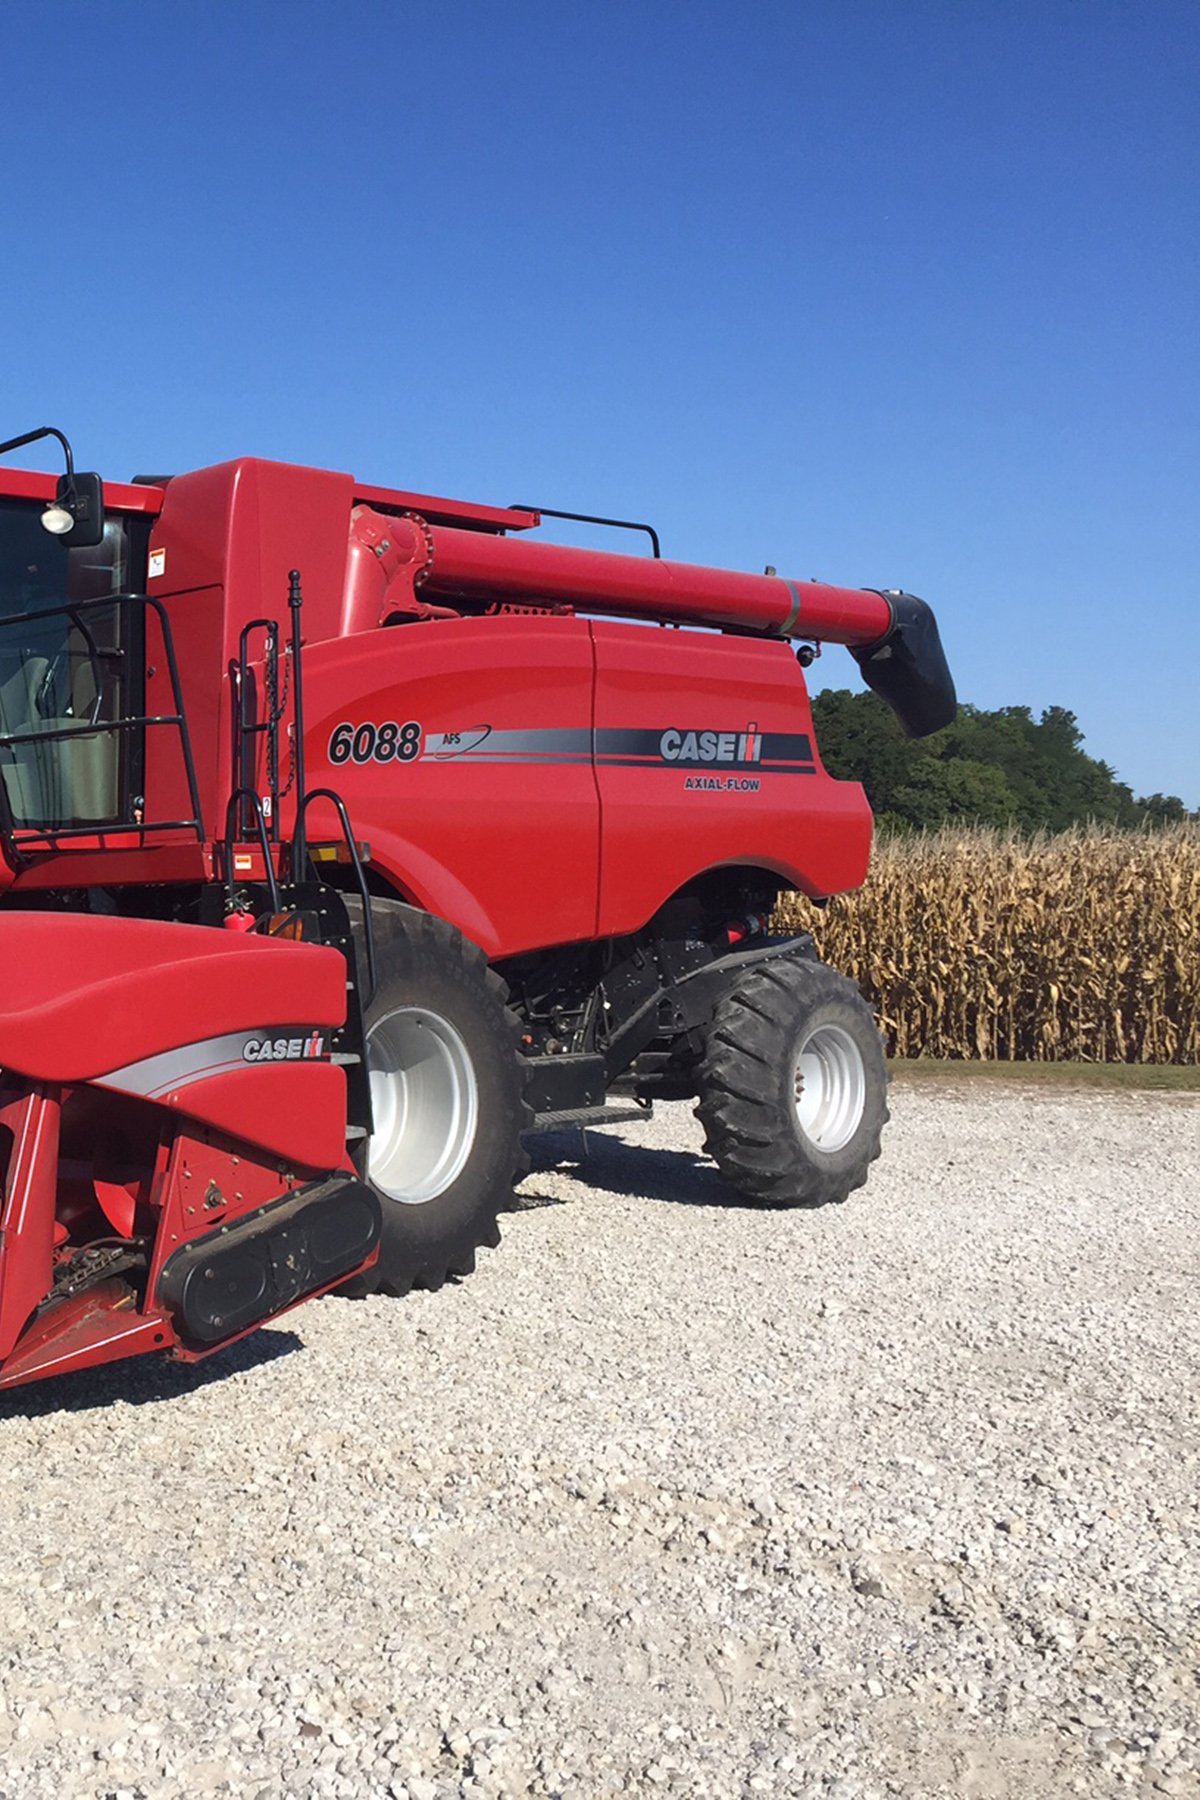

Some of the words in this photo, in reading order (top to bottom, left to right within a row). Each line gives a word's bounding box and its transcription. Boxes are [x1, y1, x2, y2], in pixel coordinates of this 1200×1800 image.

[328, 720, 422, 766] 6088
[442, 732, 462, 745] AFS
[684, 776, 760, 792] AXIAL-FLOW
